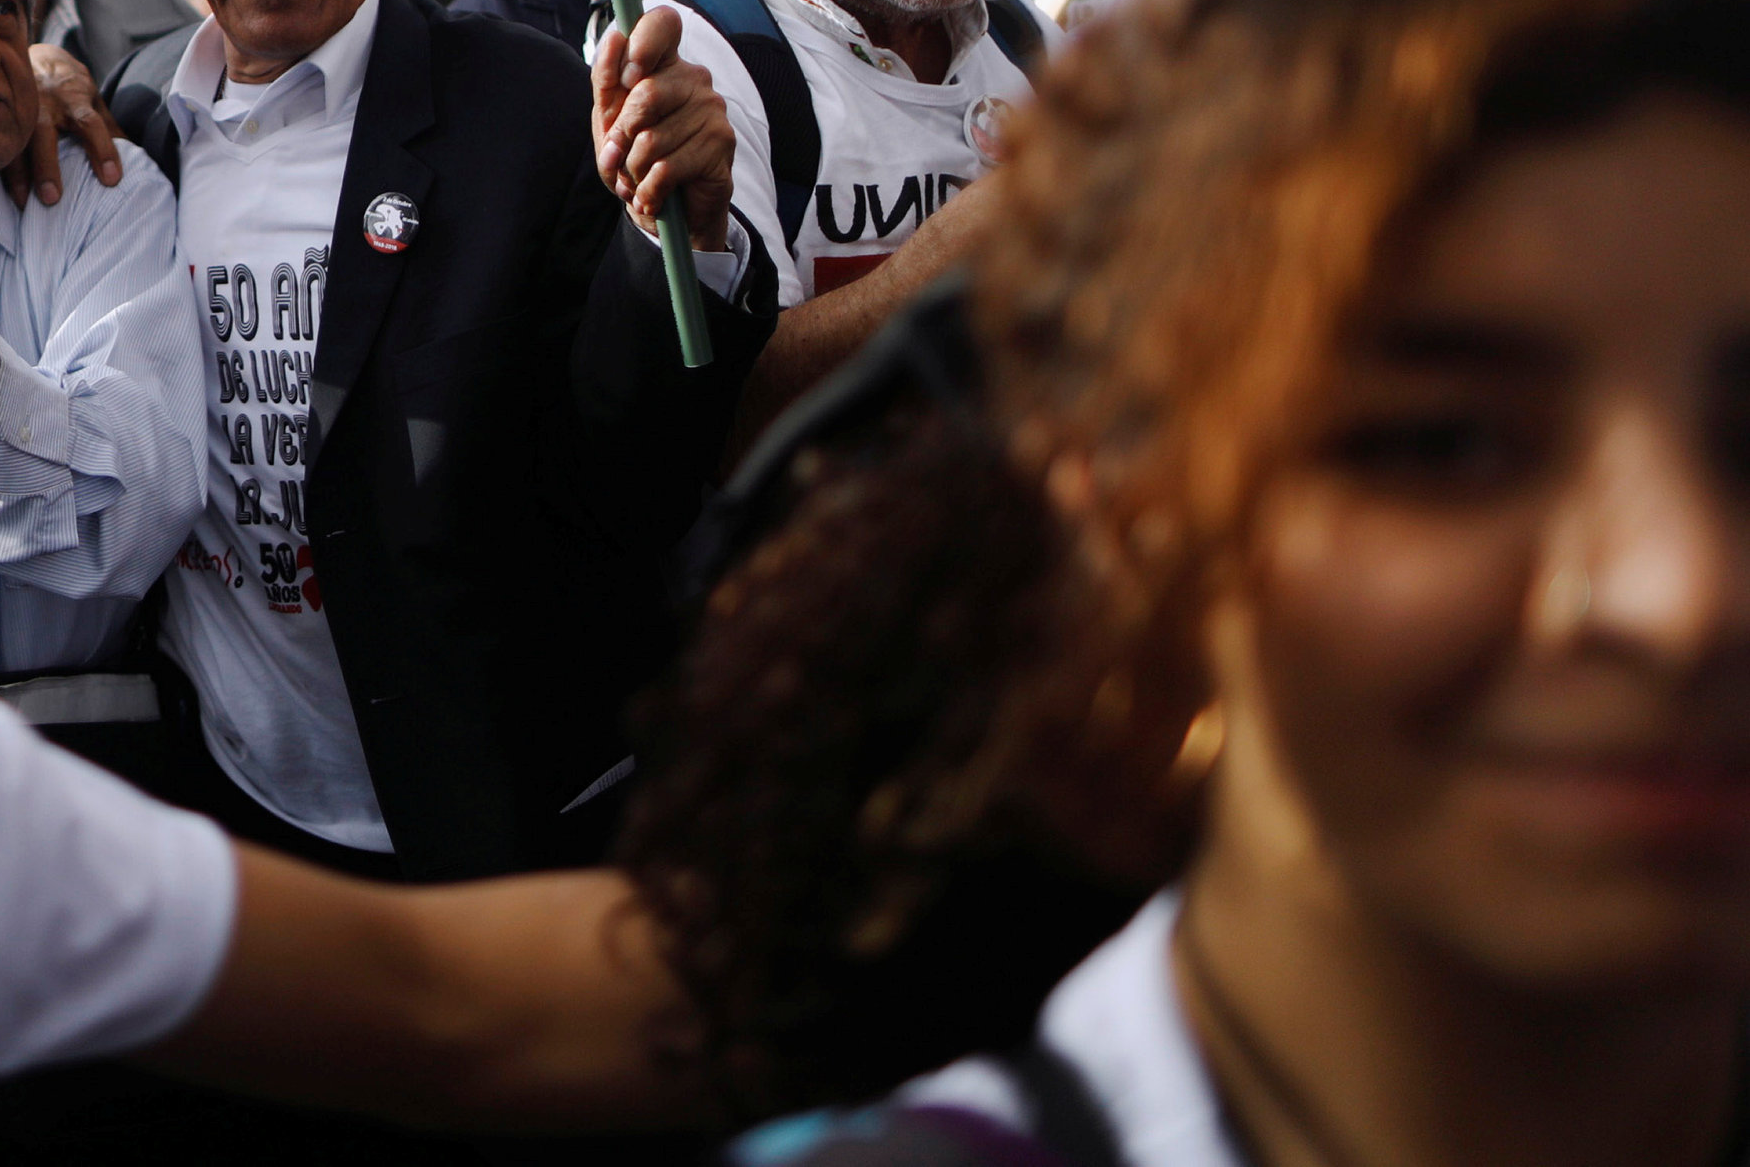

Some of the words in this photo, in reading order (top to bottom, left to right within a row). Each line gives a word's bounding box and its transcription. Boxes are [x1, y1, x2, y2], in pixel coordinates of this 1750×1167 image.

[207, 263, 259, 342] 50
[216, 350, 249, 404] DE
[221, 414, 255, 465] LA
[259, 542, 297, 583] 50
